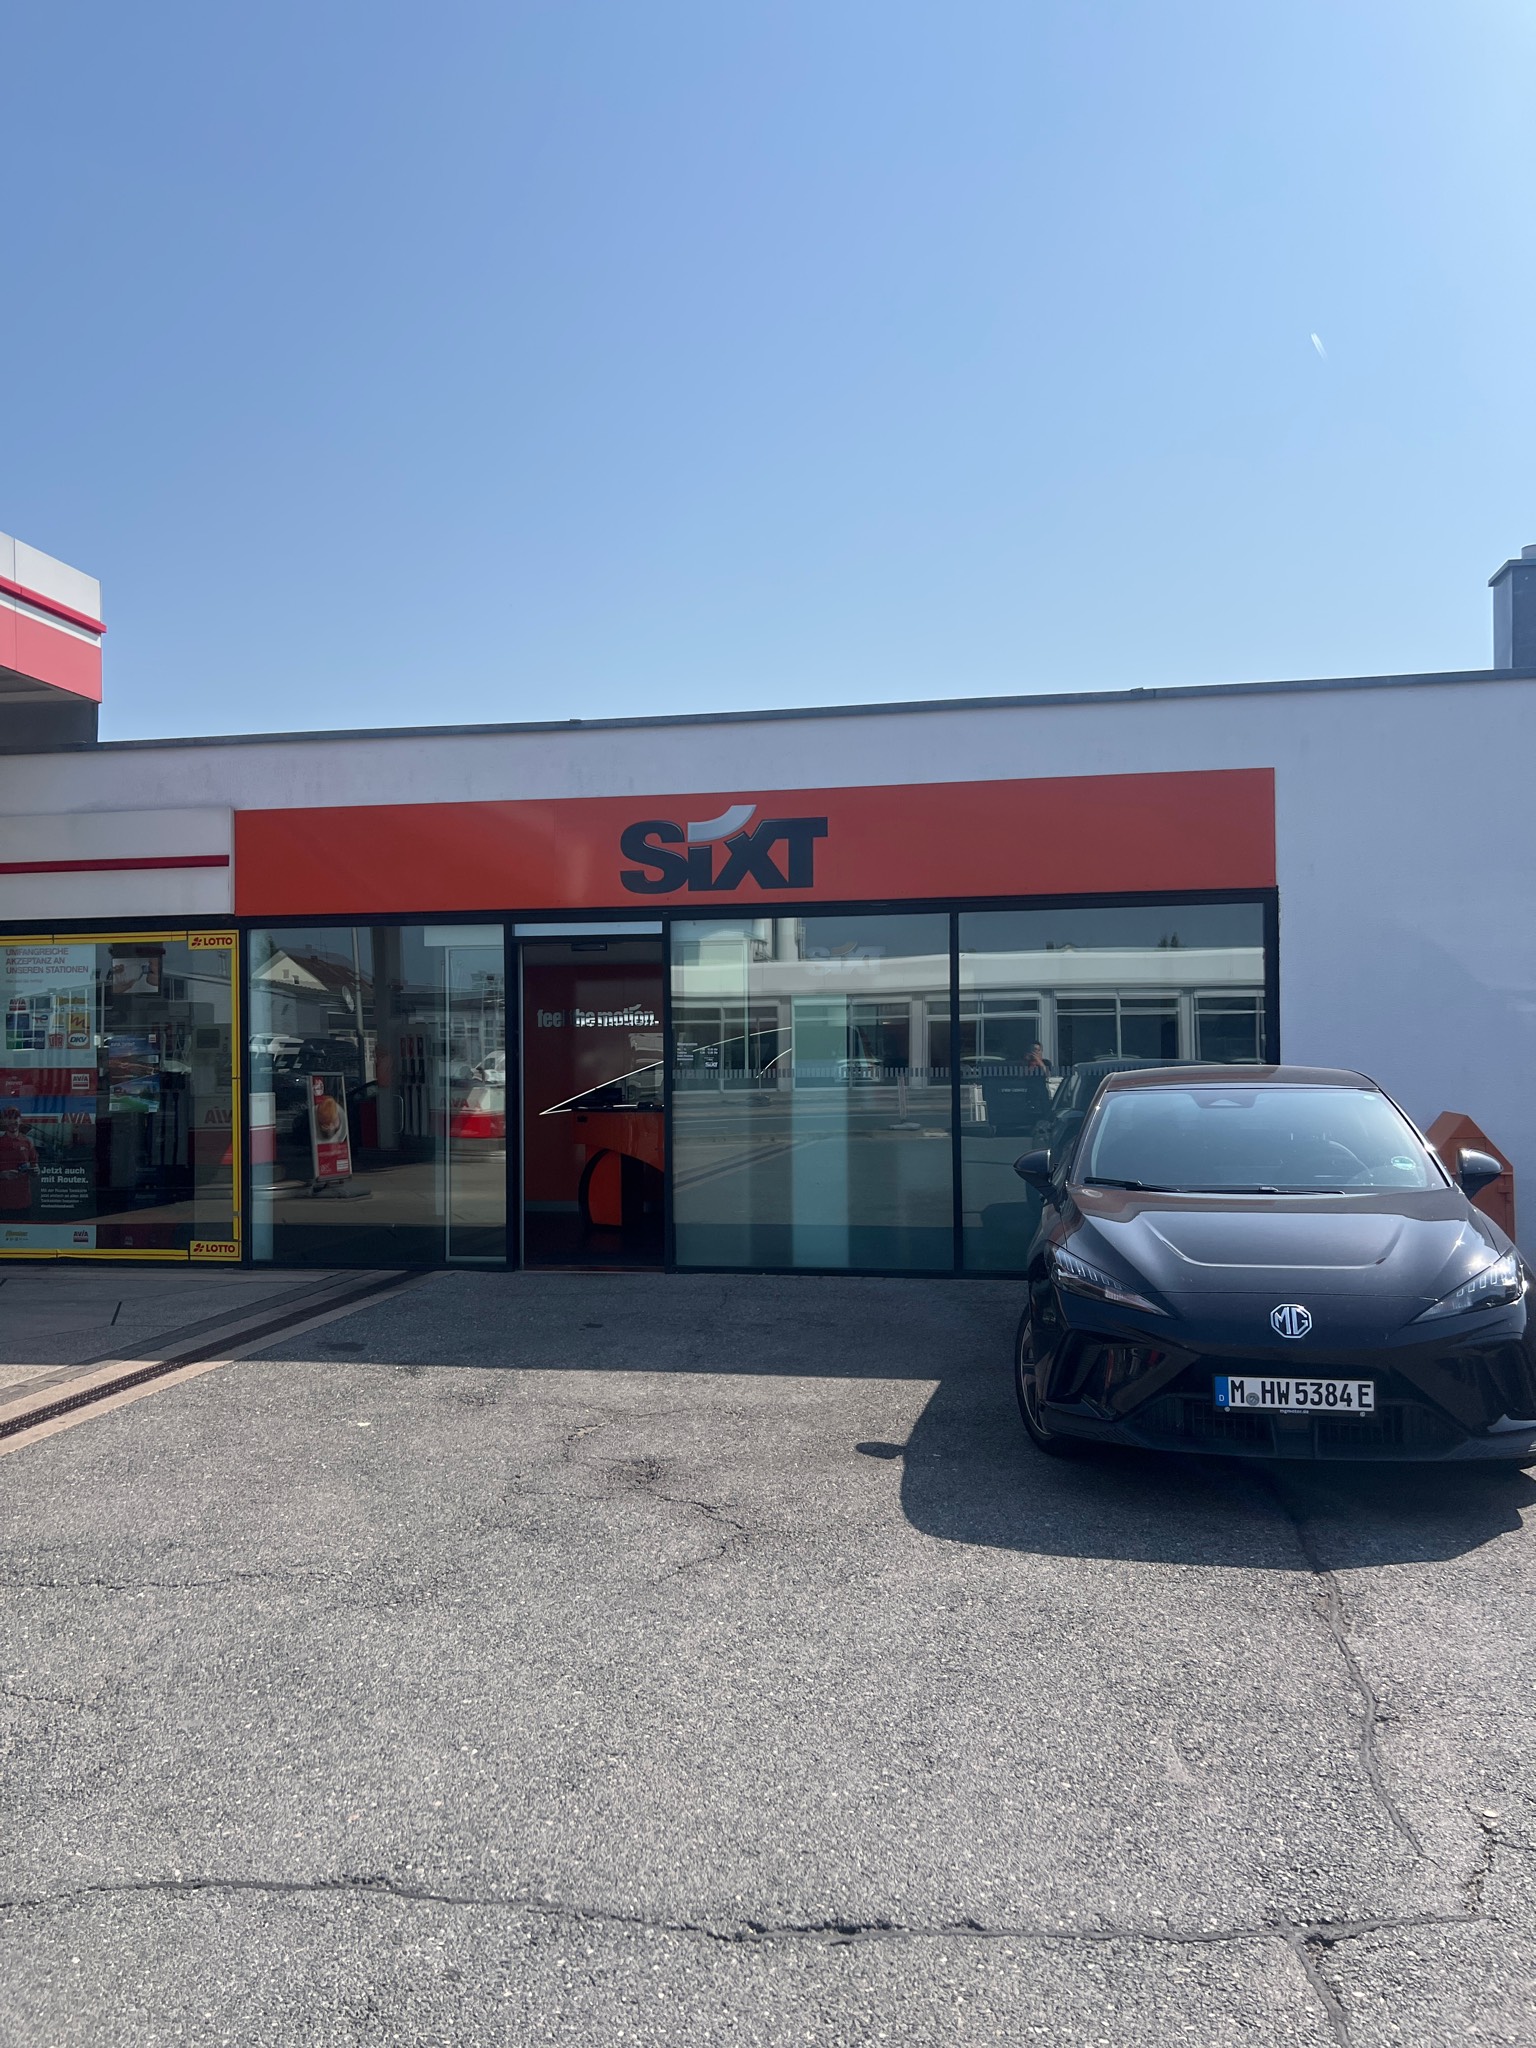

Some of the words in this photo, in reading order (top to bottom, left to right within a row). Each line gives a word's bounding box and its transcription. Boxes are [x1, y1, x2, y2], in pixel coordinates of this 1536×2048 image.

[620, 804, 828, 894] SIXT
[204, 937, 232, 946] LOTTO
[6, 947, 70, 956] UMFANGREICHE
[6, 957, 52, 966] AKZEPTANZ
[54, 957, 66, 965] AN
[6, 966, 44, 975] UNSEREN
[46, 965, 89, 974] STATIONEN
[41, 1166, 63, 1175] Jetzt
[64, 1166, 86, 1175] auch
[57, 1176, 89, 1184] Routex.
[206, 1244, 235, 1253] LOTTO
[1274, 1306, 1309, 1335] MG
